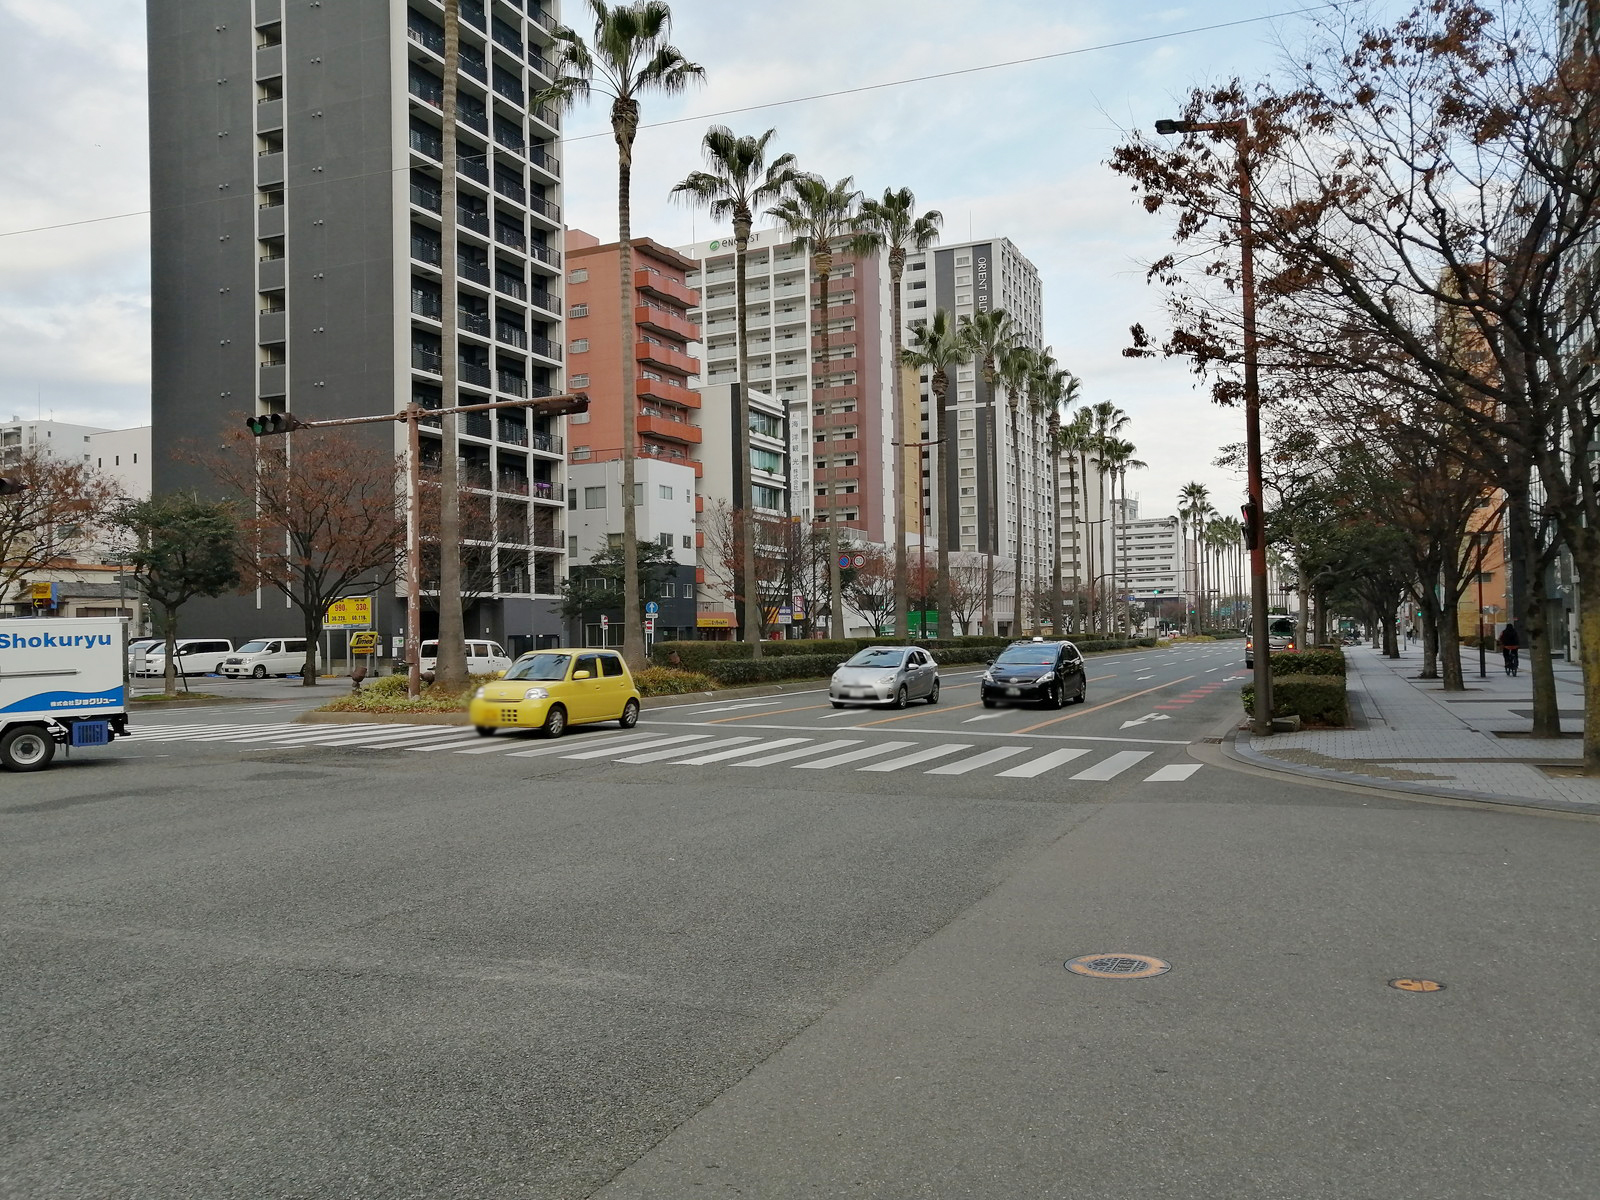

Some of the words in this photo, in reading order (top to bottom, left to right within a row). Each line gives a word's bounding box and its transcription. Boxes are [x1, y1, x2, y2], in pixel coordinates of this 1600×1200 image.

[721, 233, 759, 247] eNCST
[978, 256, 987, 291] ORIENT
[978, 295, 988, 313] BLD
[0, 632, 111, 649] Shokuryu
